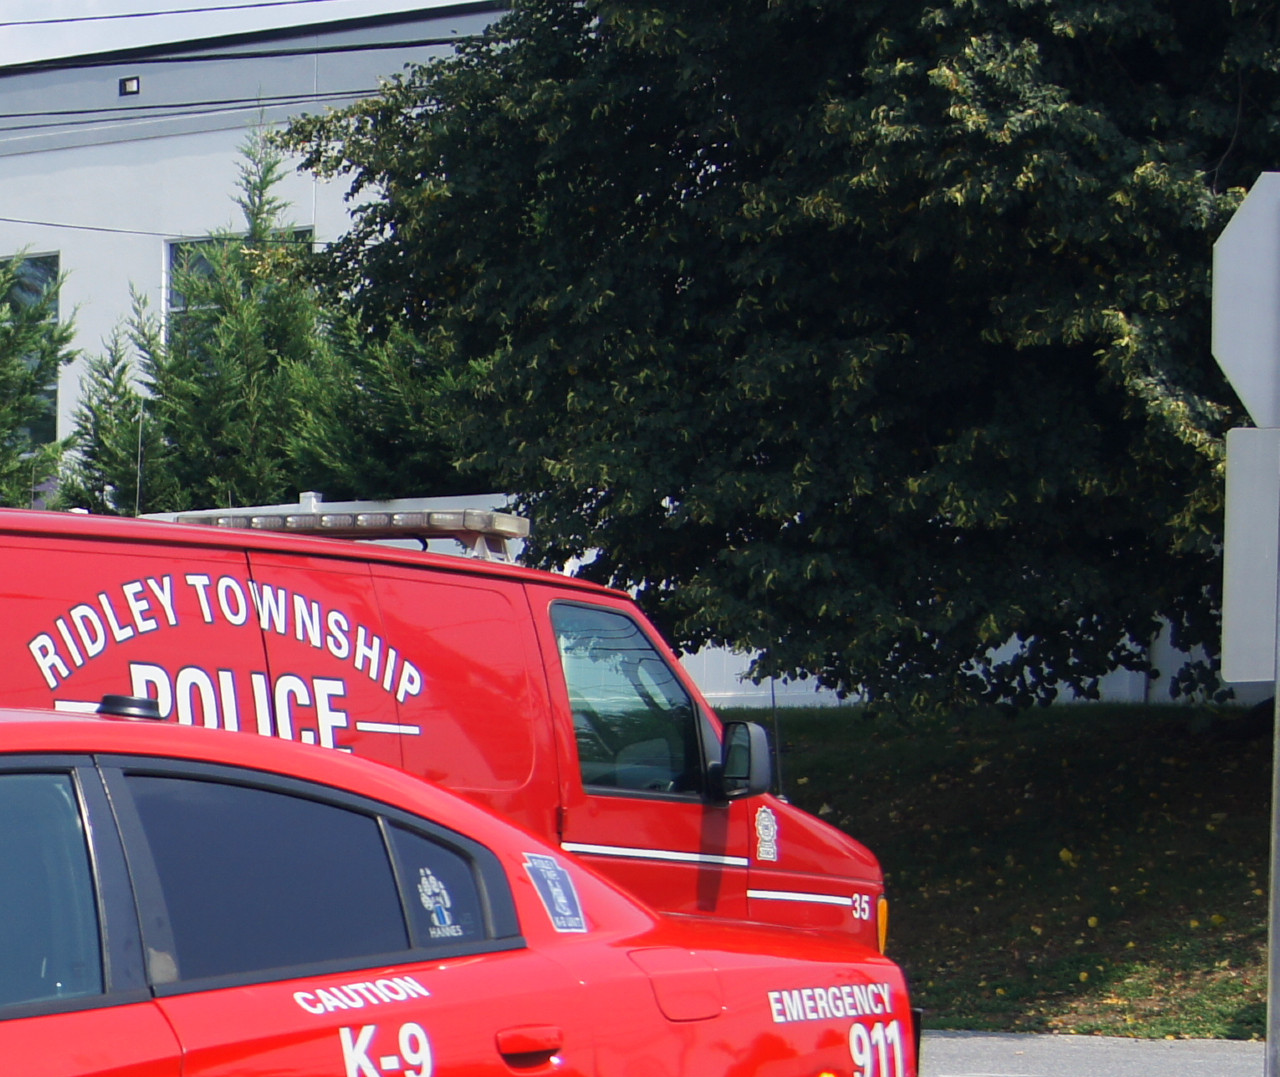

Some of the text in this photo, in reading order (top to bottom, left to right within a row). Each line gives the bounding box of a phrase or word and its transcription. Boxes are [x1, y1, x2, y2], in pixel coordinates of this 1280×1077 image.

[28, 573, 424, 703] RIDLEY TOWNSHIP
[852, 894, 870, 920] 35
[429, 925, 464, 938] HANNES
[293, 975, 430, 1014] CAUTION
[767, 983, 893, 1022] EMERGENCY
